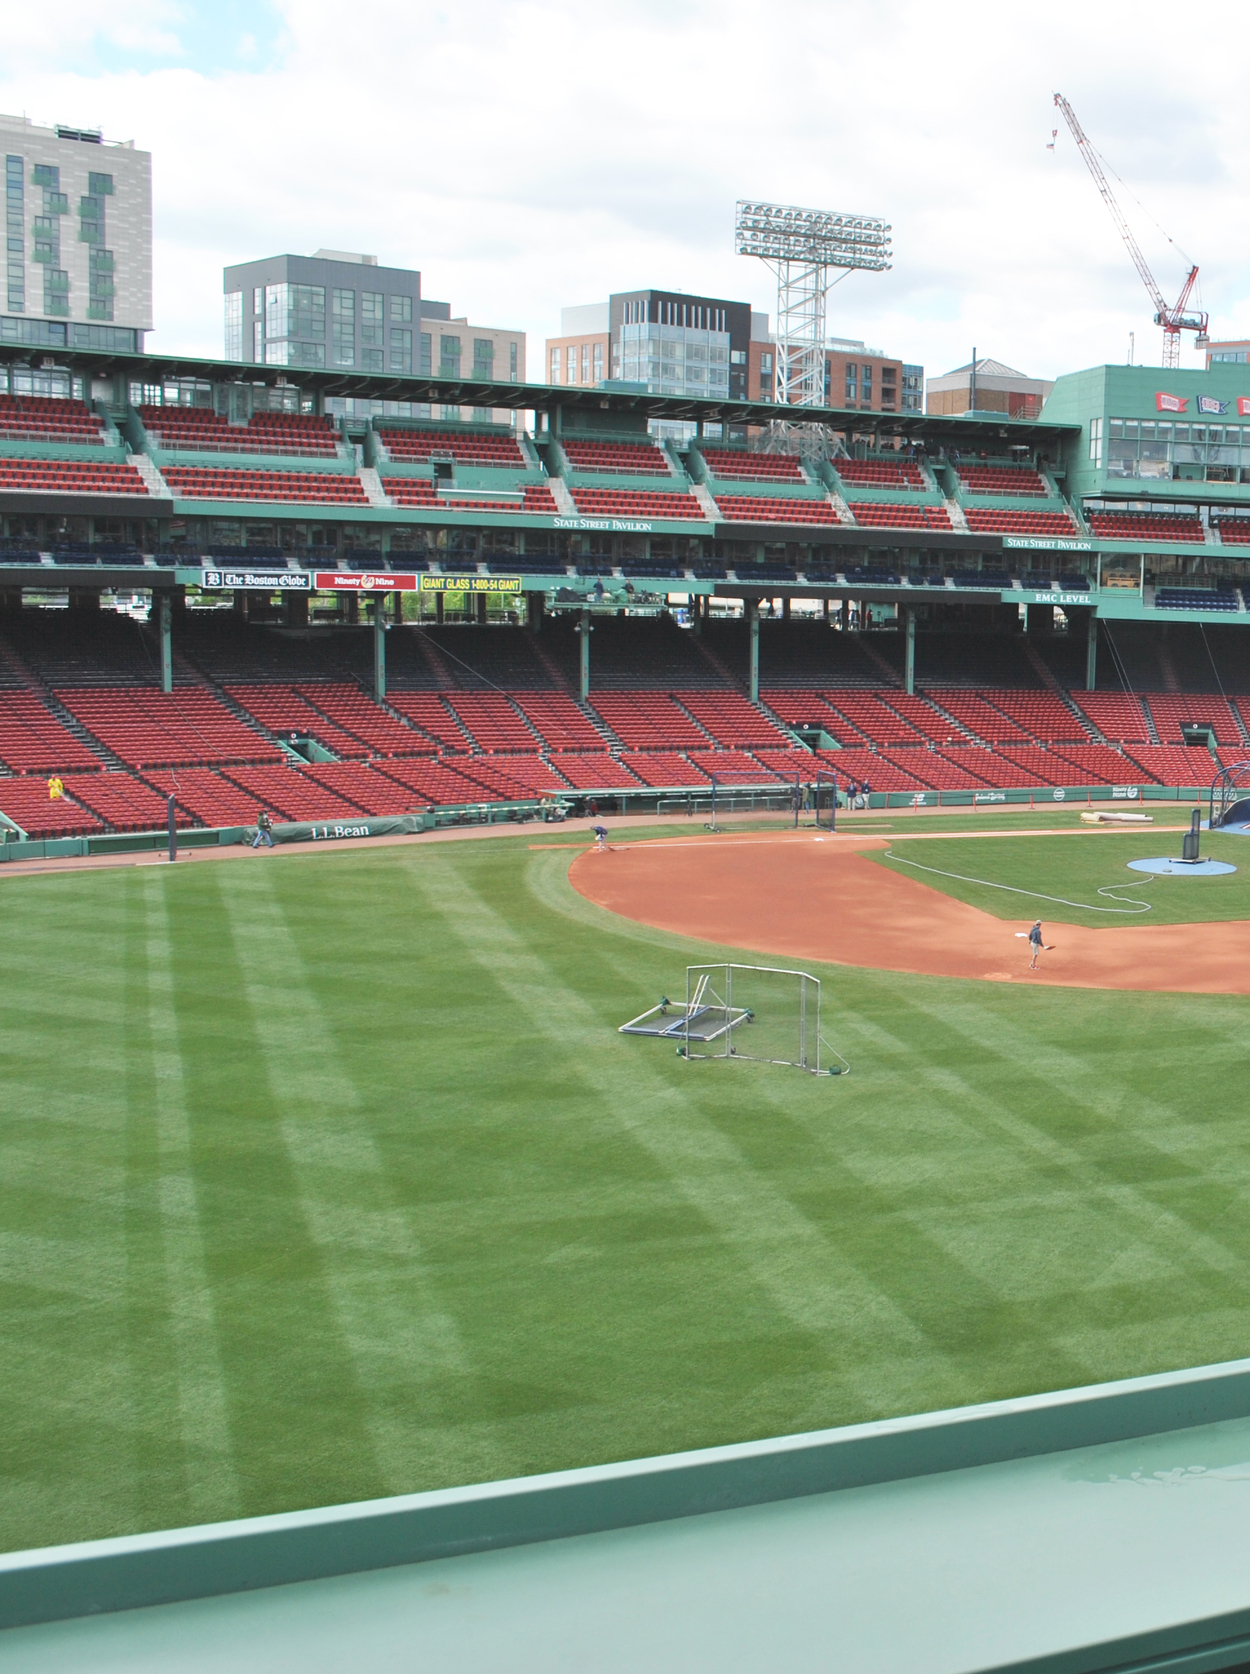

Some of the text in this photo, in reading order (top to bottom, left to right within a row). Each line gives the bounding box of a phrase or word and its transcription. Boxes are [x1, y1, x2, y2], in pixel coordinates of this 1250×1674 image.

[225, 574, 306, 586] The Boston Globe
[334, 577, 395, 586] Ninety Nine
[424, 578, 445, 589] GIANT
[446, 578, 470, 590] GLASS
[498, 580, 520, 591] GIANT
[1035, 593, 1091, 604] EMC LEVEL
[311, 825, 370, 840] L.L.Bean
